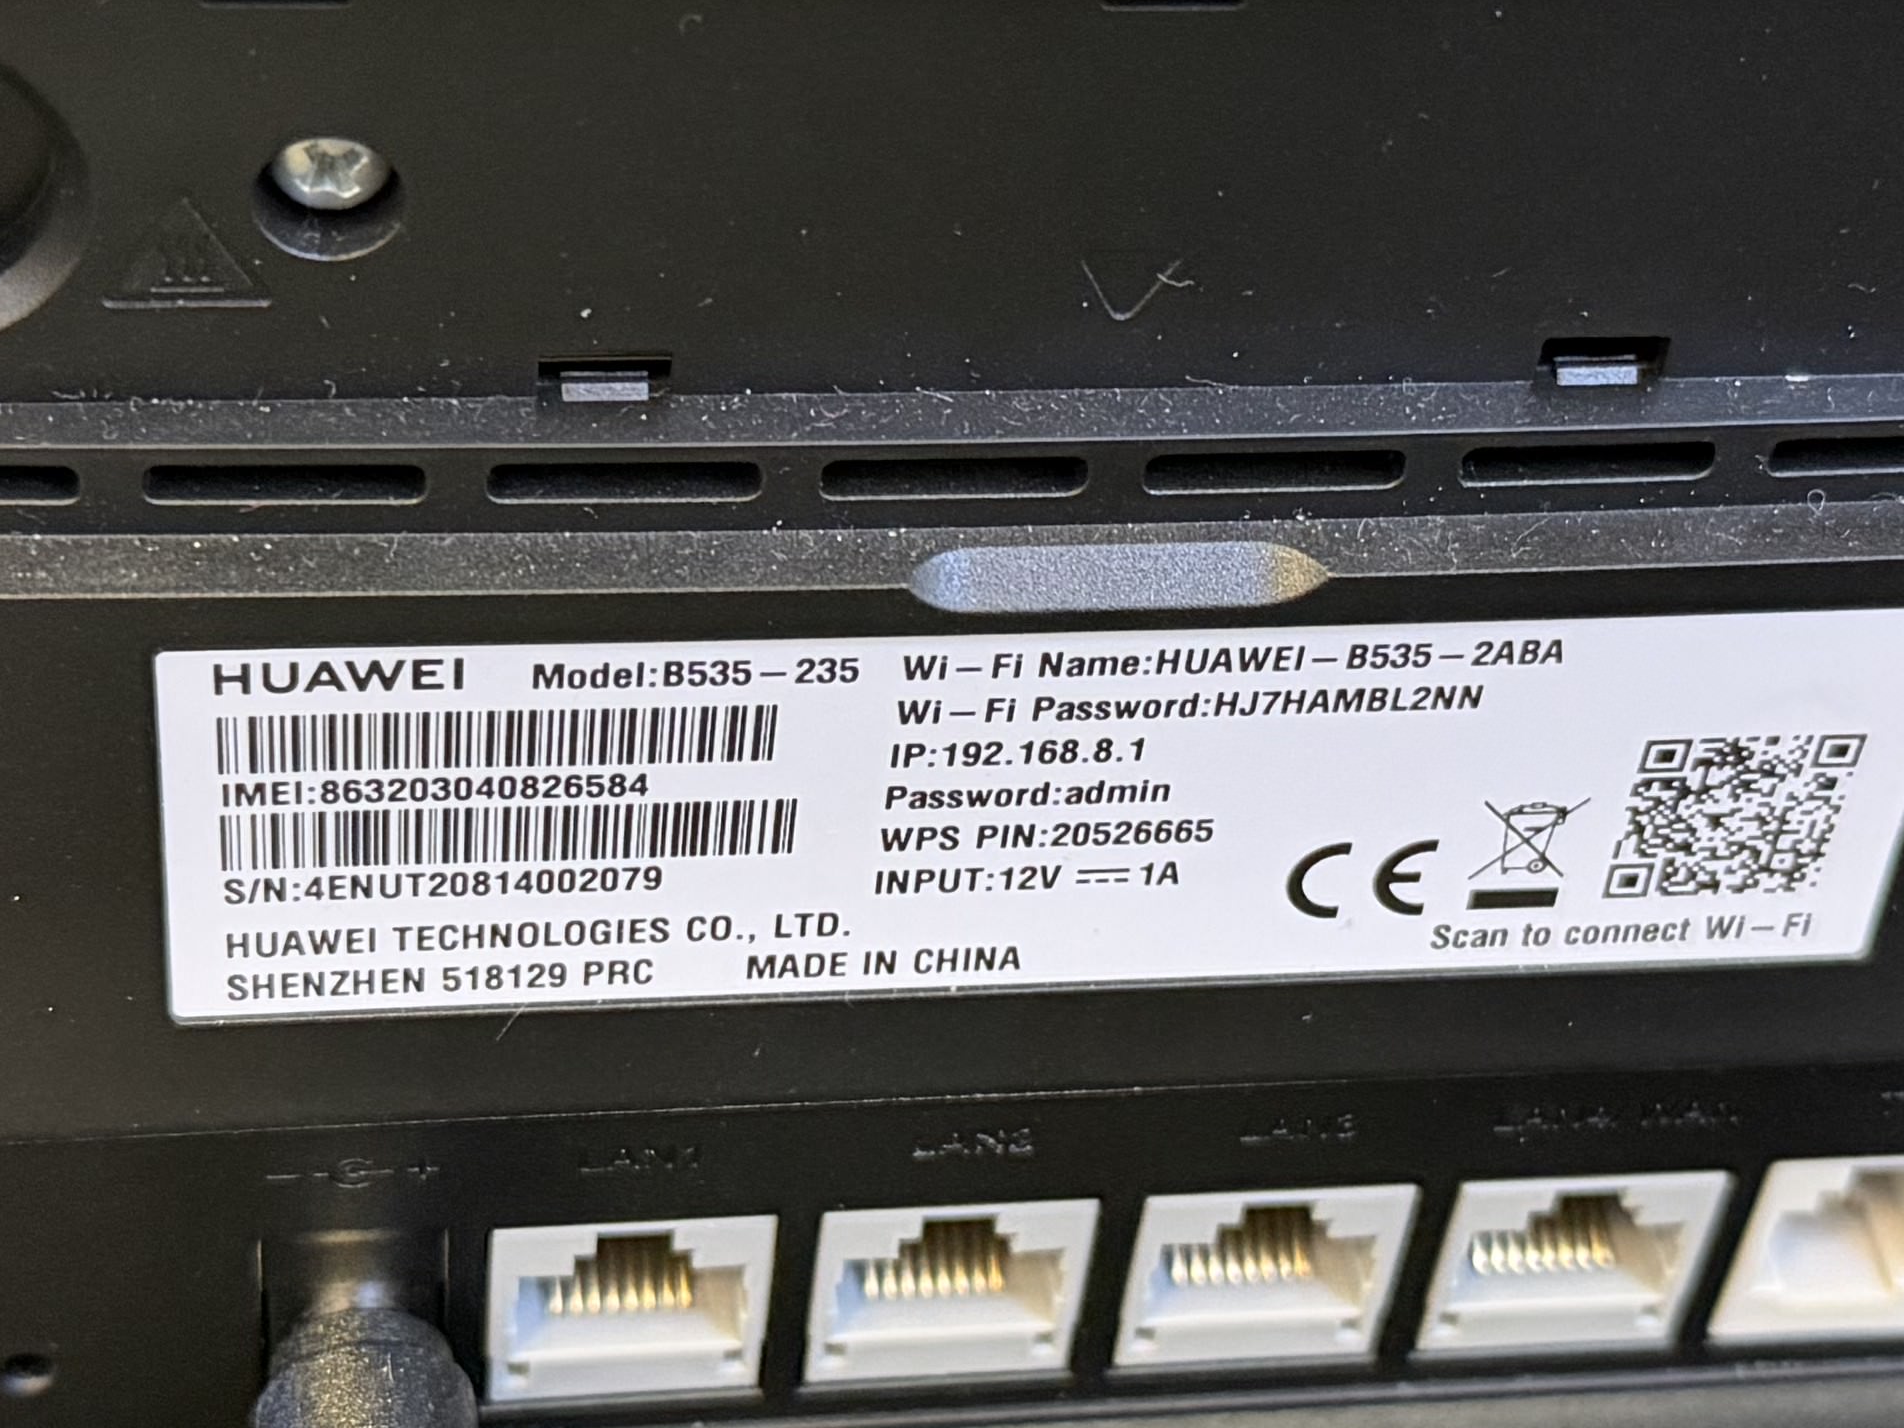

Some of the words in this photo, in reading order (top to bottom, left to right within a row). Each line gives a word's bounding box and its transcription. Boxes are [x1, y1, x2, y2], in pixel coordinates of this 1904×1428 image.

[213, 657, 464, 696] HUAWEI
[1032, 684, 1484, 722] Password:HJ7HAMBL2NN
[890, 737, 1145, 769] IP:192.168.8.1
[222, 773, 649, 807] IMEI:863203040826584
[885, 779, 1171, 810] Password:admin
[881, 825, 960, 852] WPS
[976, 818, 1214, 849] PIN:20526665
[224, 865, 662, 905] S/N:4ENUT20814002079
[875, 865, 1062, 895] INPUT:12V
[1141, 861, 1179, 886] 1A
[226, 927, 375, 958] HUAWEI
[392, 917, 670, 951] TECHNOLOGIES
[686, 915, 755, 943] CO.,
[774, 912, 850, 938] LTD.
[1432, 924, 1508, 949] Scan
[1523, 924, 1551, 946] to
[1566, 920, 1690, 944] connect
[746, 952, 847, 979] MADE
[863, 950, 897, 975] IN
[914, 946, 1020, 974] CHINA
[227, 967, 424, 1001] SHENZHEN
[443, 963, 567, 992] 518129
[583, 959, 653, 986] PRC
